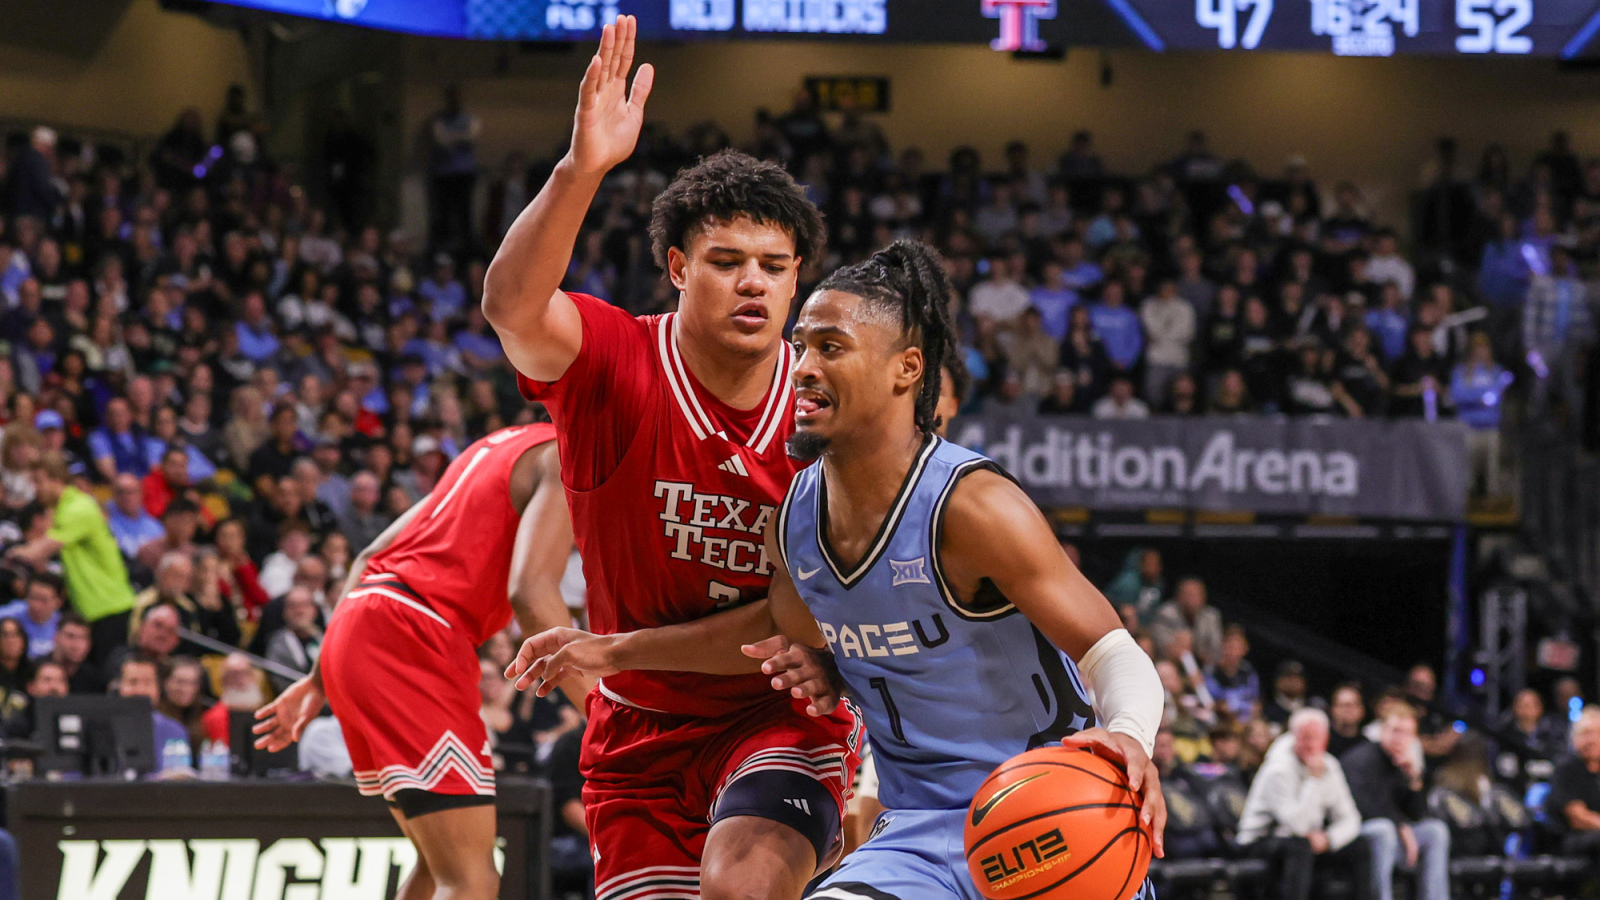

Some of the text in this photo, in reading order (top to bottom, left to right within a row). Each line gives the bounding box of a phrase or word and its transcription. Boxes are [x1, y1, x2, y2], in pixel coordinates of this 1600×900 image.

[1196, 0, 1274, 49] 47
[1455, 0, 1534, 54] 52
[1190, 428, 1358, 497] Arena
[653, 480, 775, 535] TEXA
[815, 613, 950, 658] PACEU
[869, 677, 912, 747] 1
[57, 837, 505, 900] KNIGH
[980, 828, 1069, 884] ELITE
[991, 852, 1072, 891] CHAMPIONSHIP
